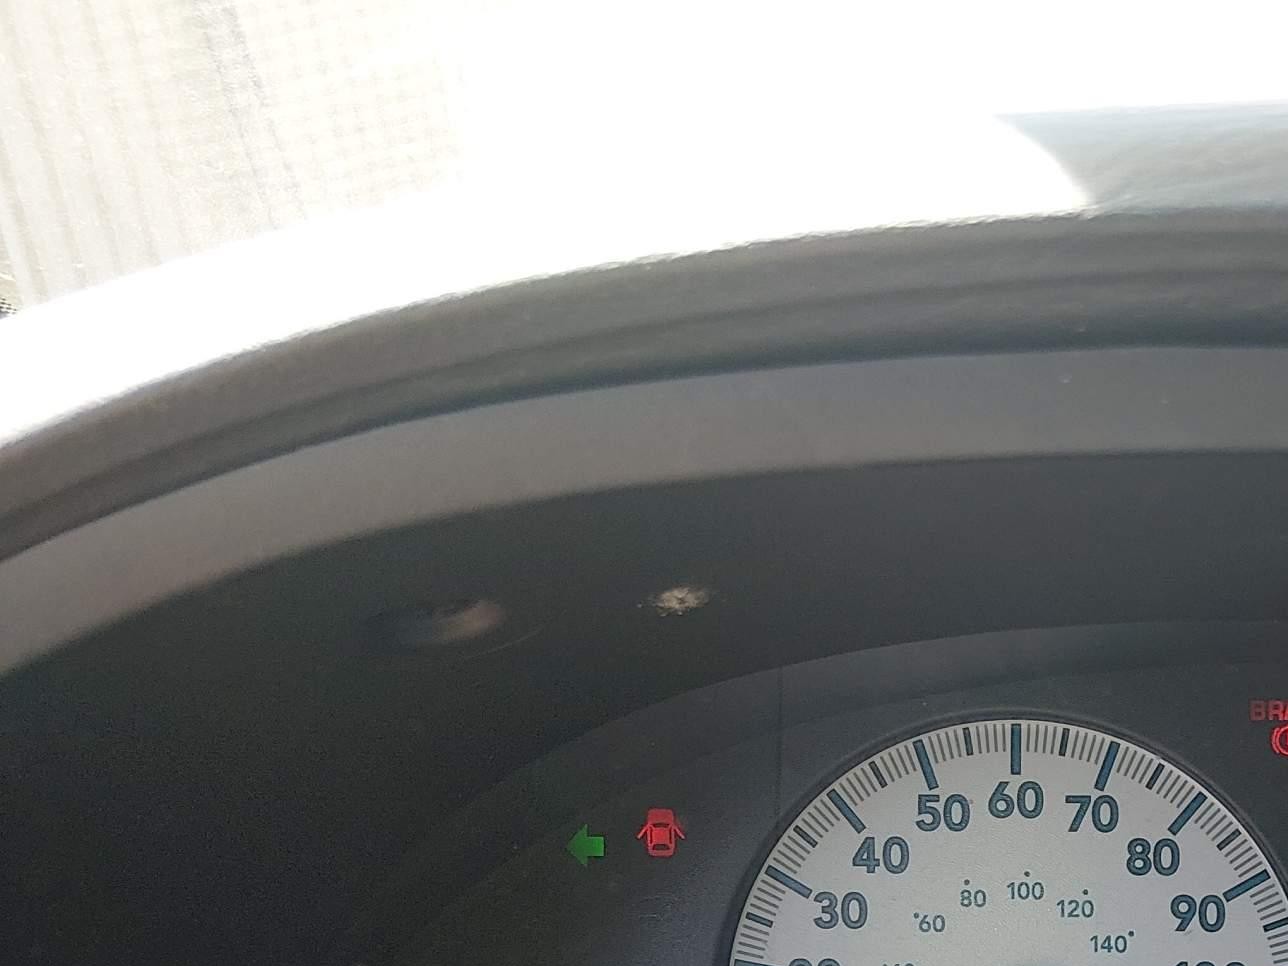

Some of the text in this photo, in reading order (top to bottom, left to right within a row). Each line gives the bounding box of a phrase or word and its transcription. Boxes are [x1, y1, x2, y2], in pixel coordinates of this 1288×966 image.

[915, 794, 970, 832] 50
[988, 781, 1044, 819] 60
[1065, 795, 1119, 833] 70
[852, 836, 909, 874] 40
[1126, 838, 1180, 876] 80
[813, 891, 867, 929] 30
[961, 890, 986, 907] 80
[1007, 882, 1044, 900] 100
[1057, 900, 1094, 918] 120
[919, 915, 945, 933] 60
[1171, 894, 1225, 932] 90
[1090, 936, 1128, 953] 140
